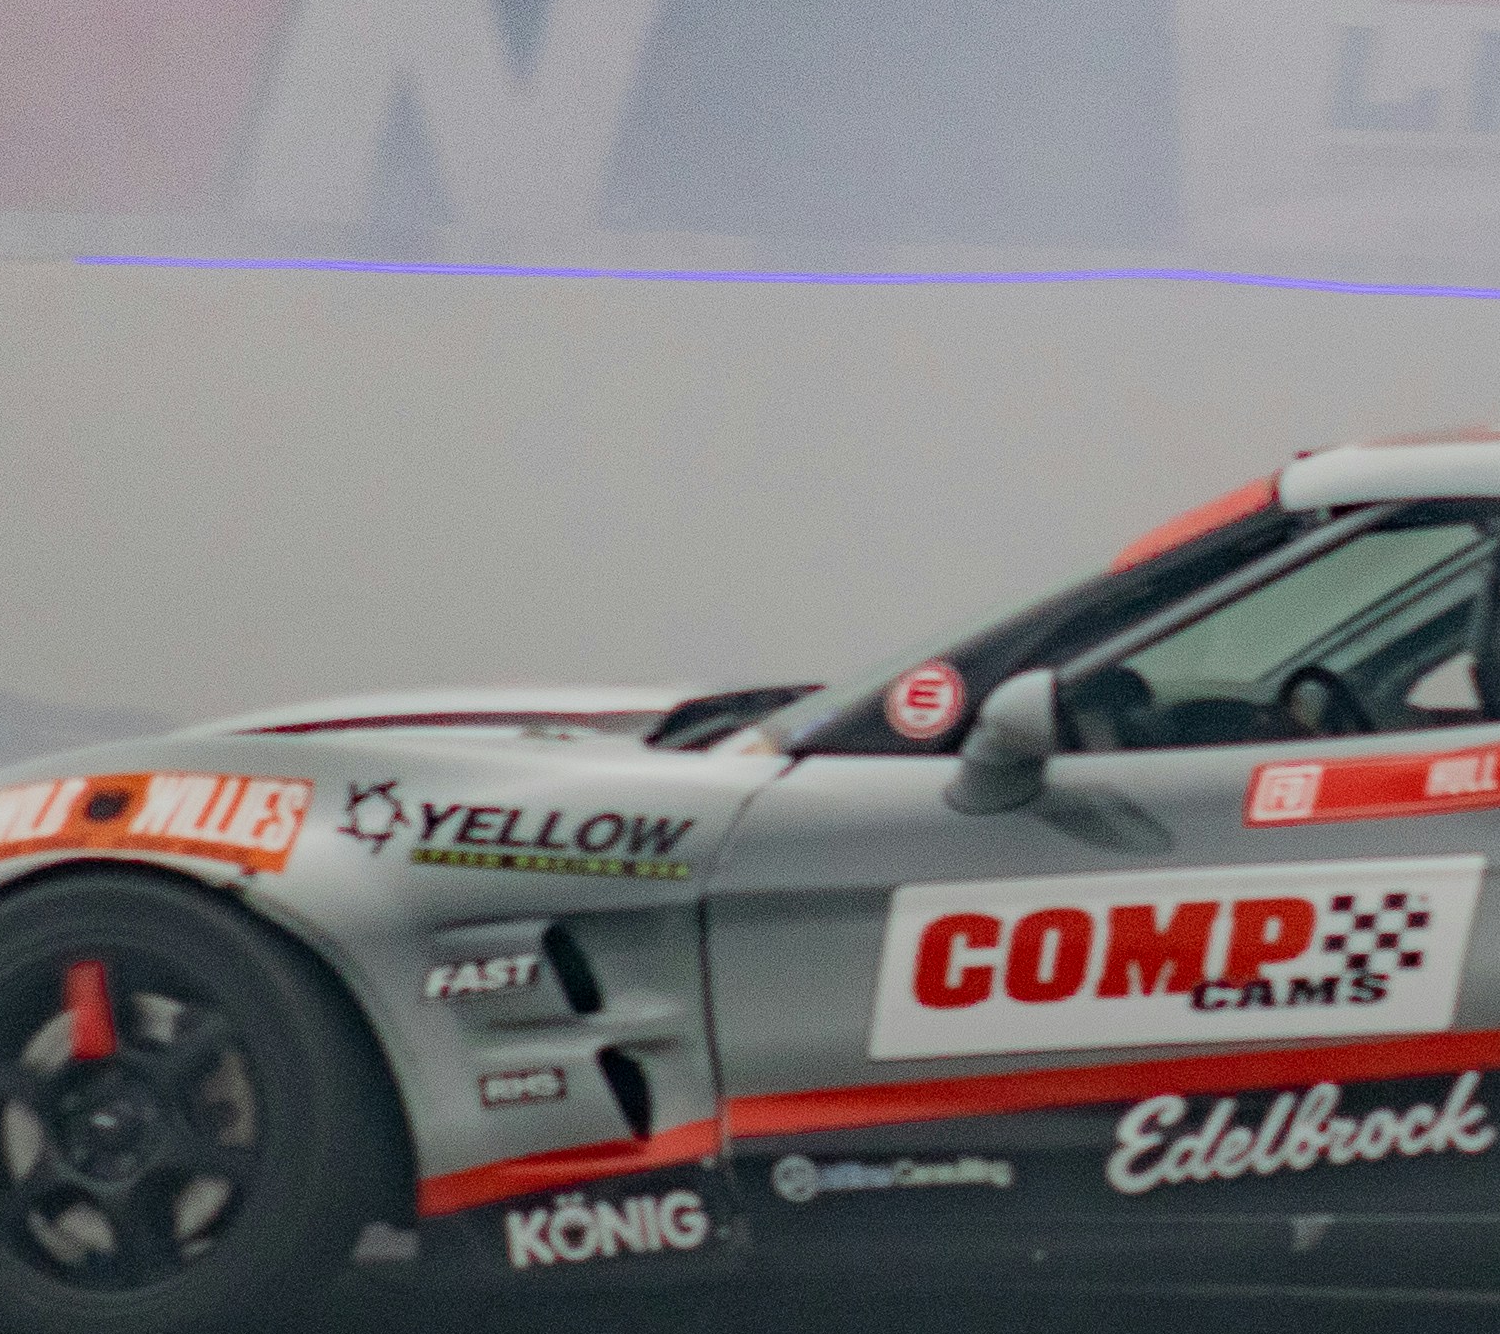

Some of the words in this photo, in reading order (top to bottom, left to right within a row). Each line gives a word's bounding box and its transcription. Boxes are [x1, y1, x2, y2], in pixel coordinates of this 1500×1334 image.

[418, 801, 697, 856] YELLOW
[423, 953, 540, 999] FAST
[912, 895, 1317, 1011] COMP
[1188, 969, 1389, 1015] CAMS
[1104, 1069, 1498, 1195] Edelbrock
[504, 1189, 710, 1269] KÖNIG
